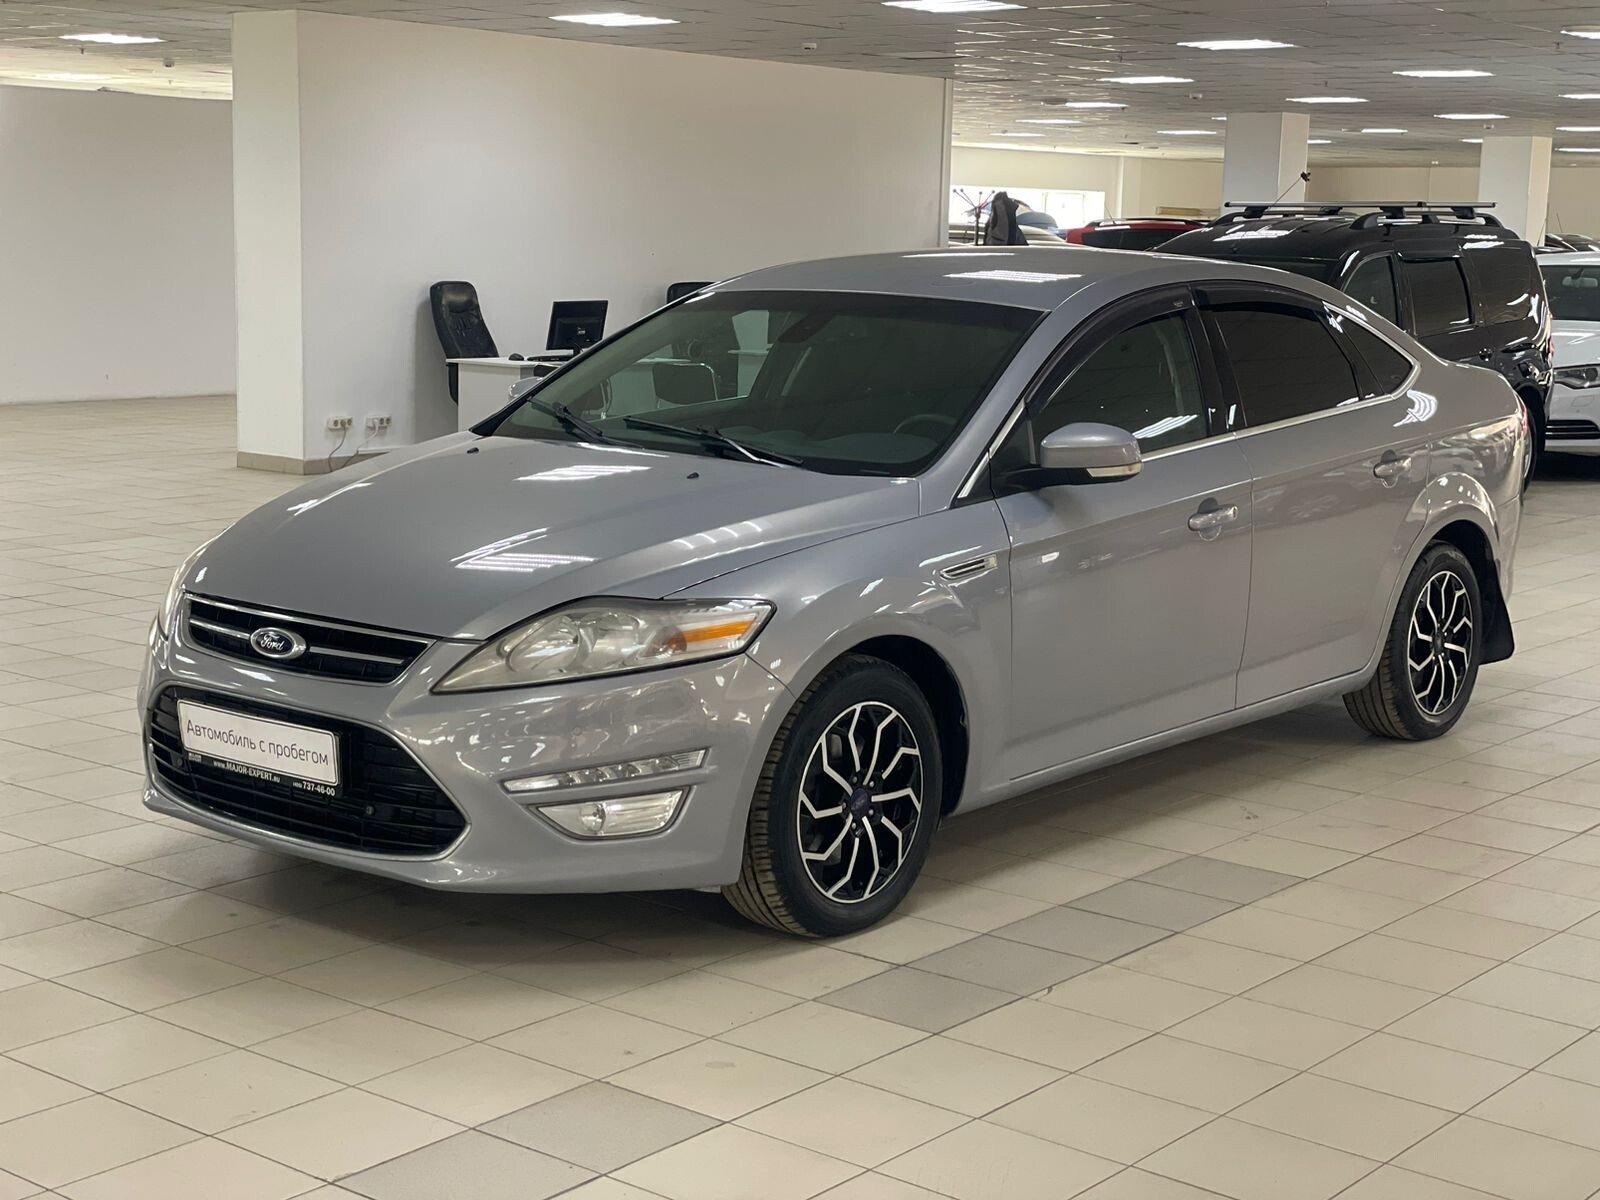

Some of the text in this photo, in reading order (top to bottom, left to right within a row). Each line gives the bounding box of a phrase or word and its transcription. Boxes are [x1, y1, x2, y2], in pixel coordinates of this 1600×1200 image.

[260, 631, 285, 651] Ford
[187, 719, 329, 766] Автомобиль с пробегом
